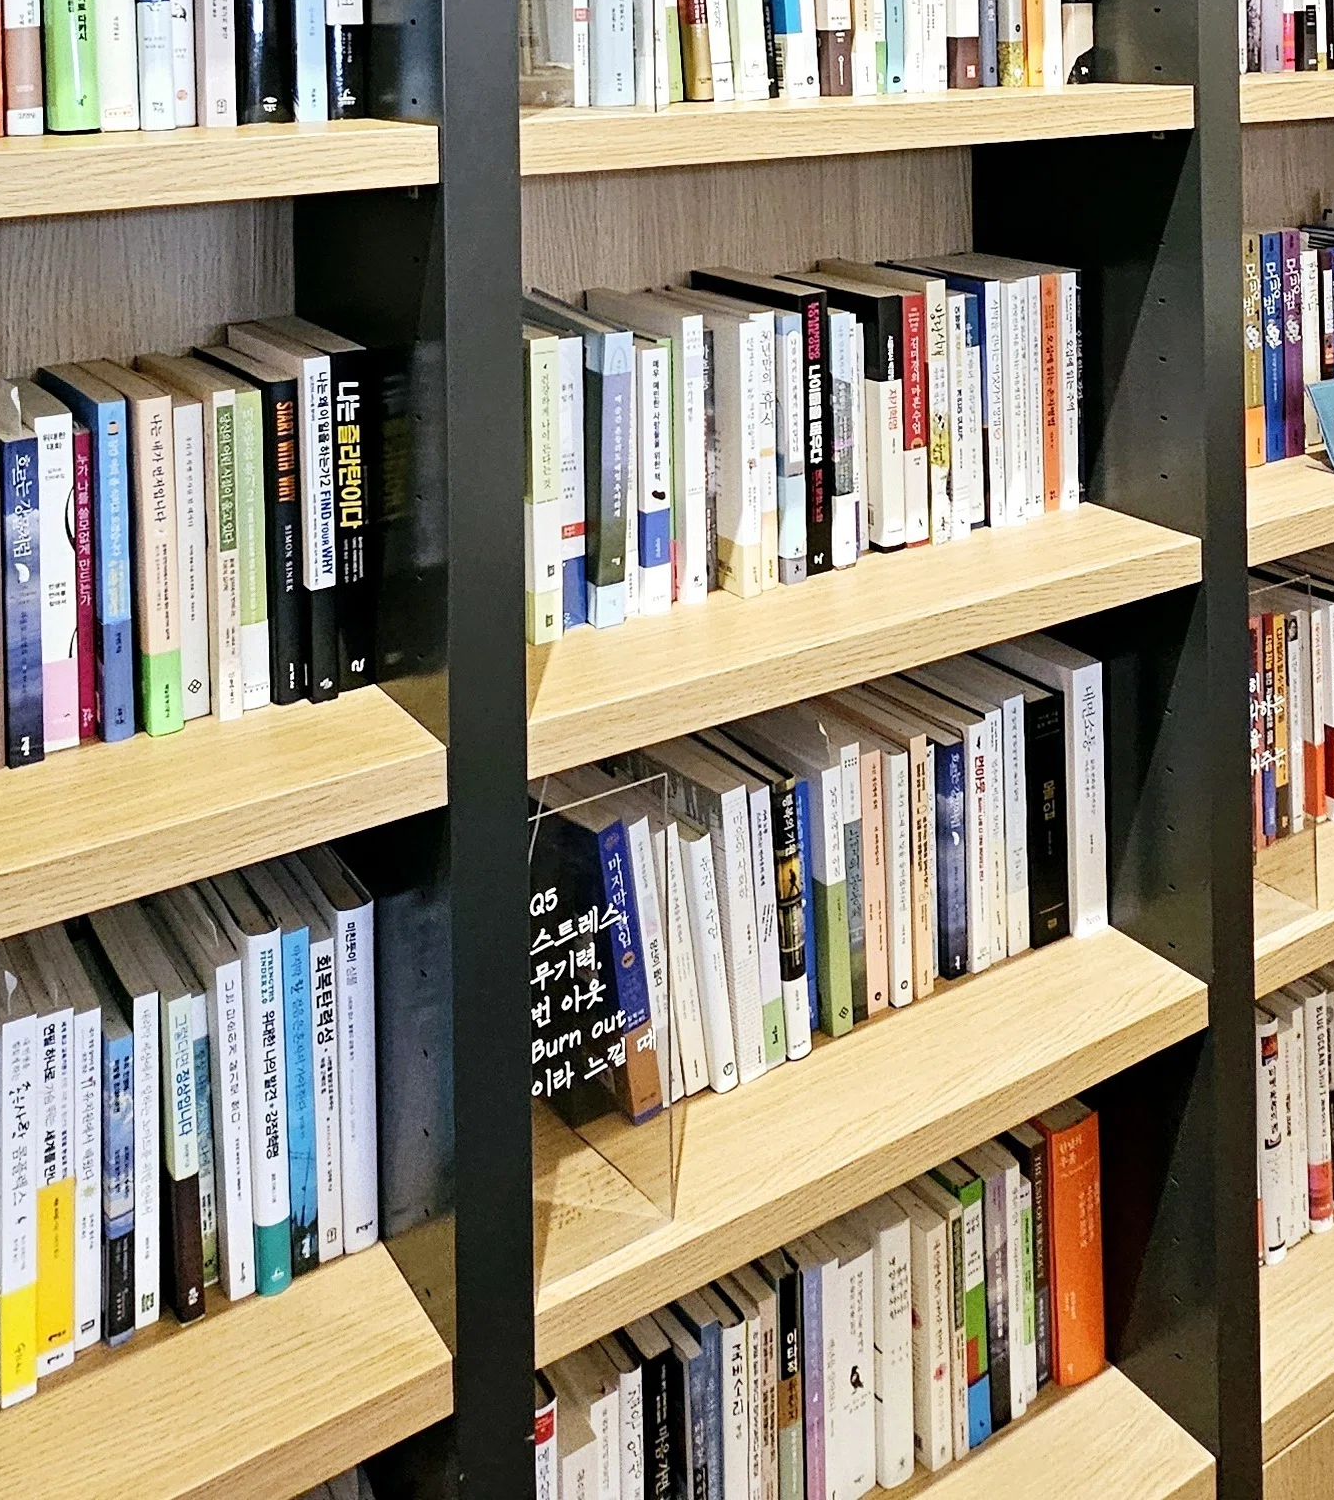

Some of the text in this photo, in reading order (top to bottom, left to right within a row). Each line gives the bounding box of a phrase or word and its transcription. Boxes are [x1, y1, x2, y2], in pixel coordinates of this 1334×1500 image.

[336, 380, 359, 422] 나는
[150, 413, 168, 523] 나는 내가 먼저입니다
[276, 401, 296, 503] START WITH WHY
[809, 422, 824, 464] 배우다
[12, 454, 34, 559] 흐르는 강물처럼
[284, 524, 294, 593] SIMON SINEK
[973, 754, 987, 794] 번아웃
[529, 888, 558, 917] Q5
[608, 852, 627, 908] 마지막
[314, 954, 335, 1046] 회복탄력성
[531, 981, 607, 1028] 번 아웃
[531, 1027, 658, 1098] 이라 느낄 때
[533, 1009, 627, 1064] Burn out
